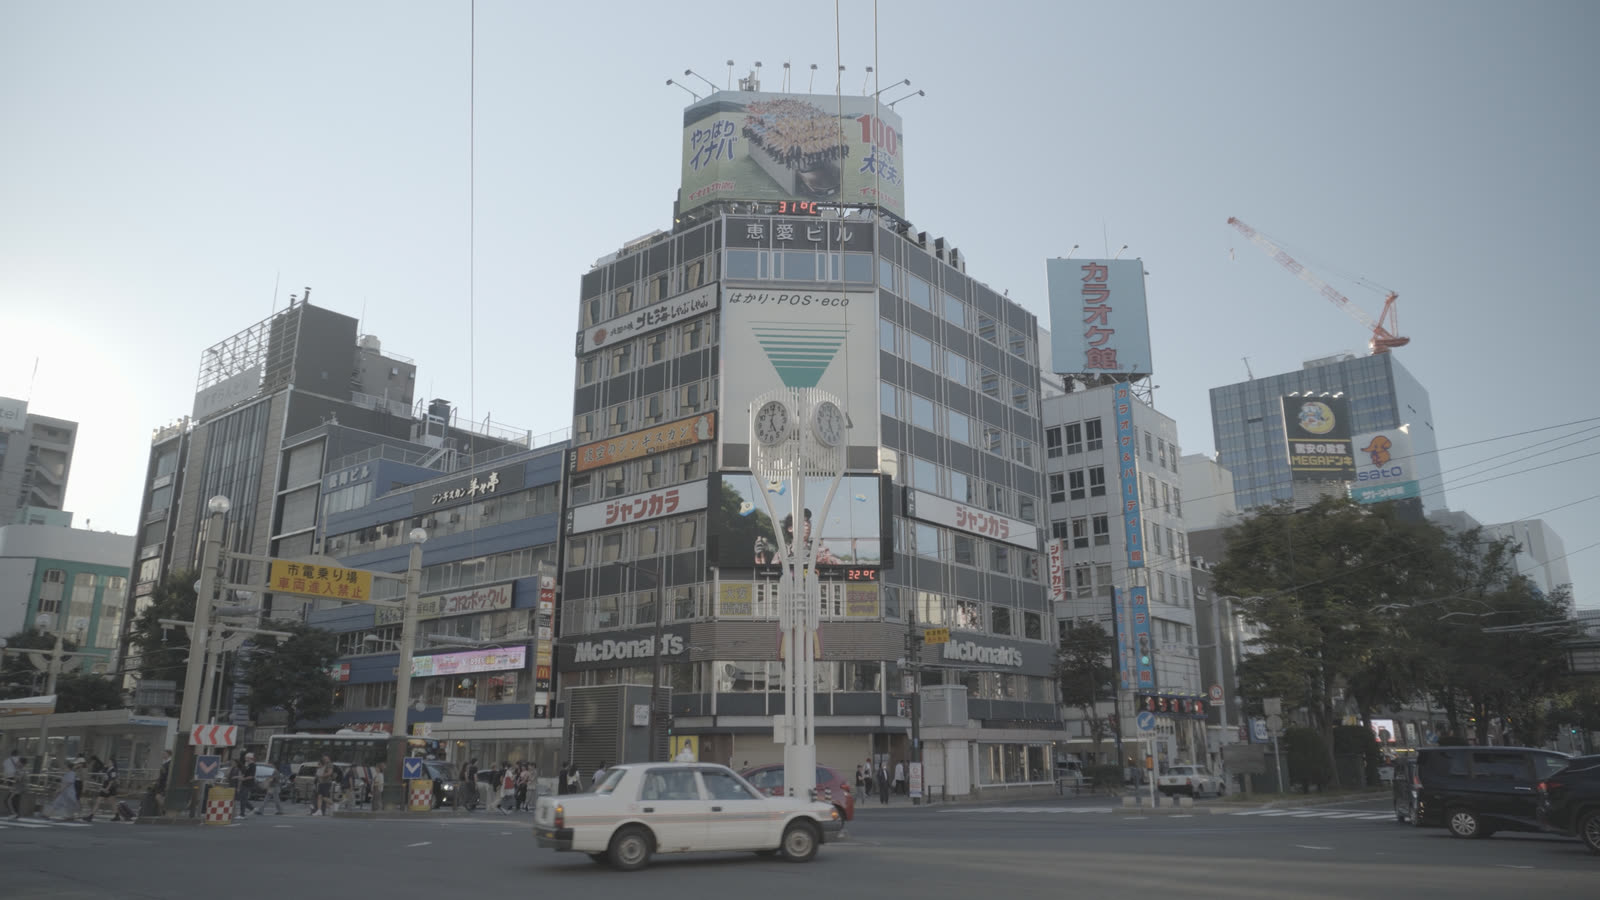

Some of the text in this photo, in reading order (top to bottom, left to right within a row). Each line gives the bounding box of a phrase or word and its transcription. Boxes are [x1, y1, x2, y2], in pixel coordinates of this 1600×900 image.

[690, 120, 736, 151] やっぱり
[690, 137, 738, 171] イナバ
[746, 223, 853, 242] 恵愛ビル
[1081, 261, 1118, 370] カラオケ館
[1291, 455, 1353, 466] MEGAドンキ
[606, 489, 680, 525] ジャンカラ
[956, 506, 1009, 540] ジャンカラ
[287, 563, 358, 584] 市電乗り場
[1051, 544, 1062, 597] ジャンカラ
[278, 576, 363, 599] 車両進入禁止
[574, 633, 684, 663] McDonal's
[943, 639, 1023, 667] McDonald's
[1135, 594, 1151, 683] カラ館
